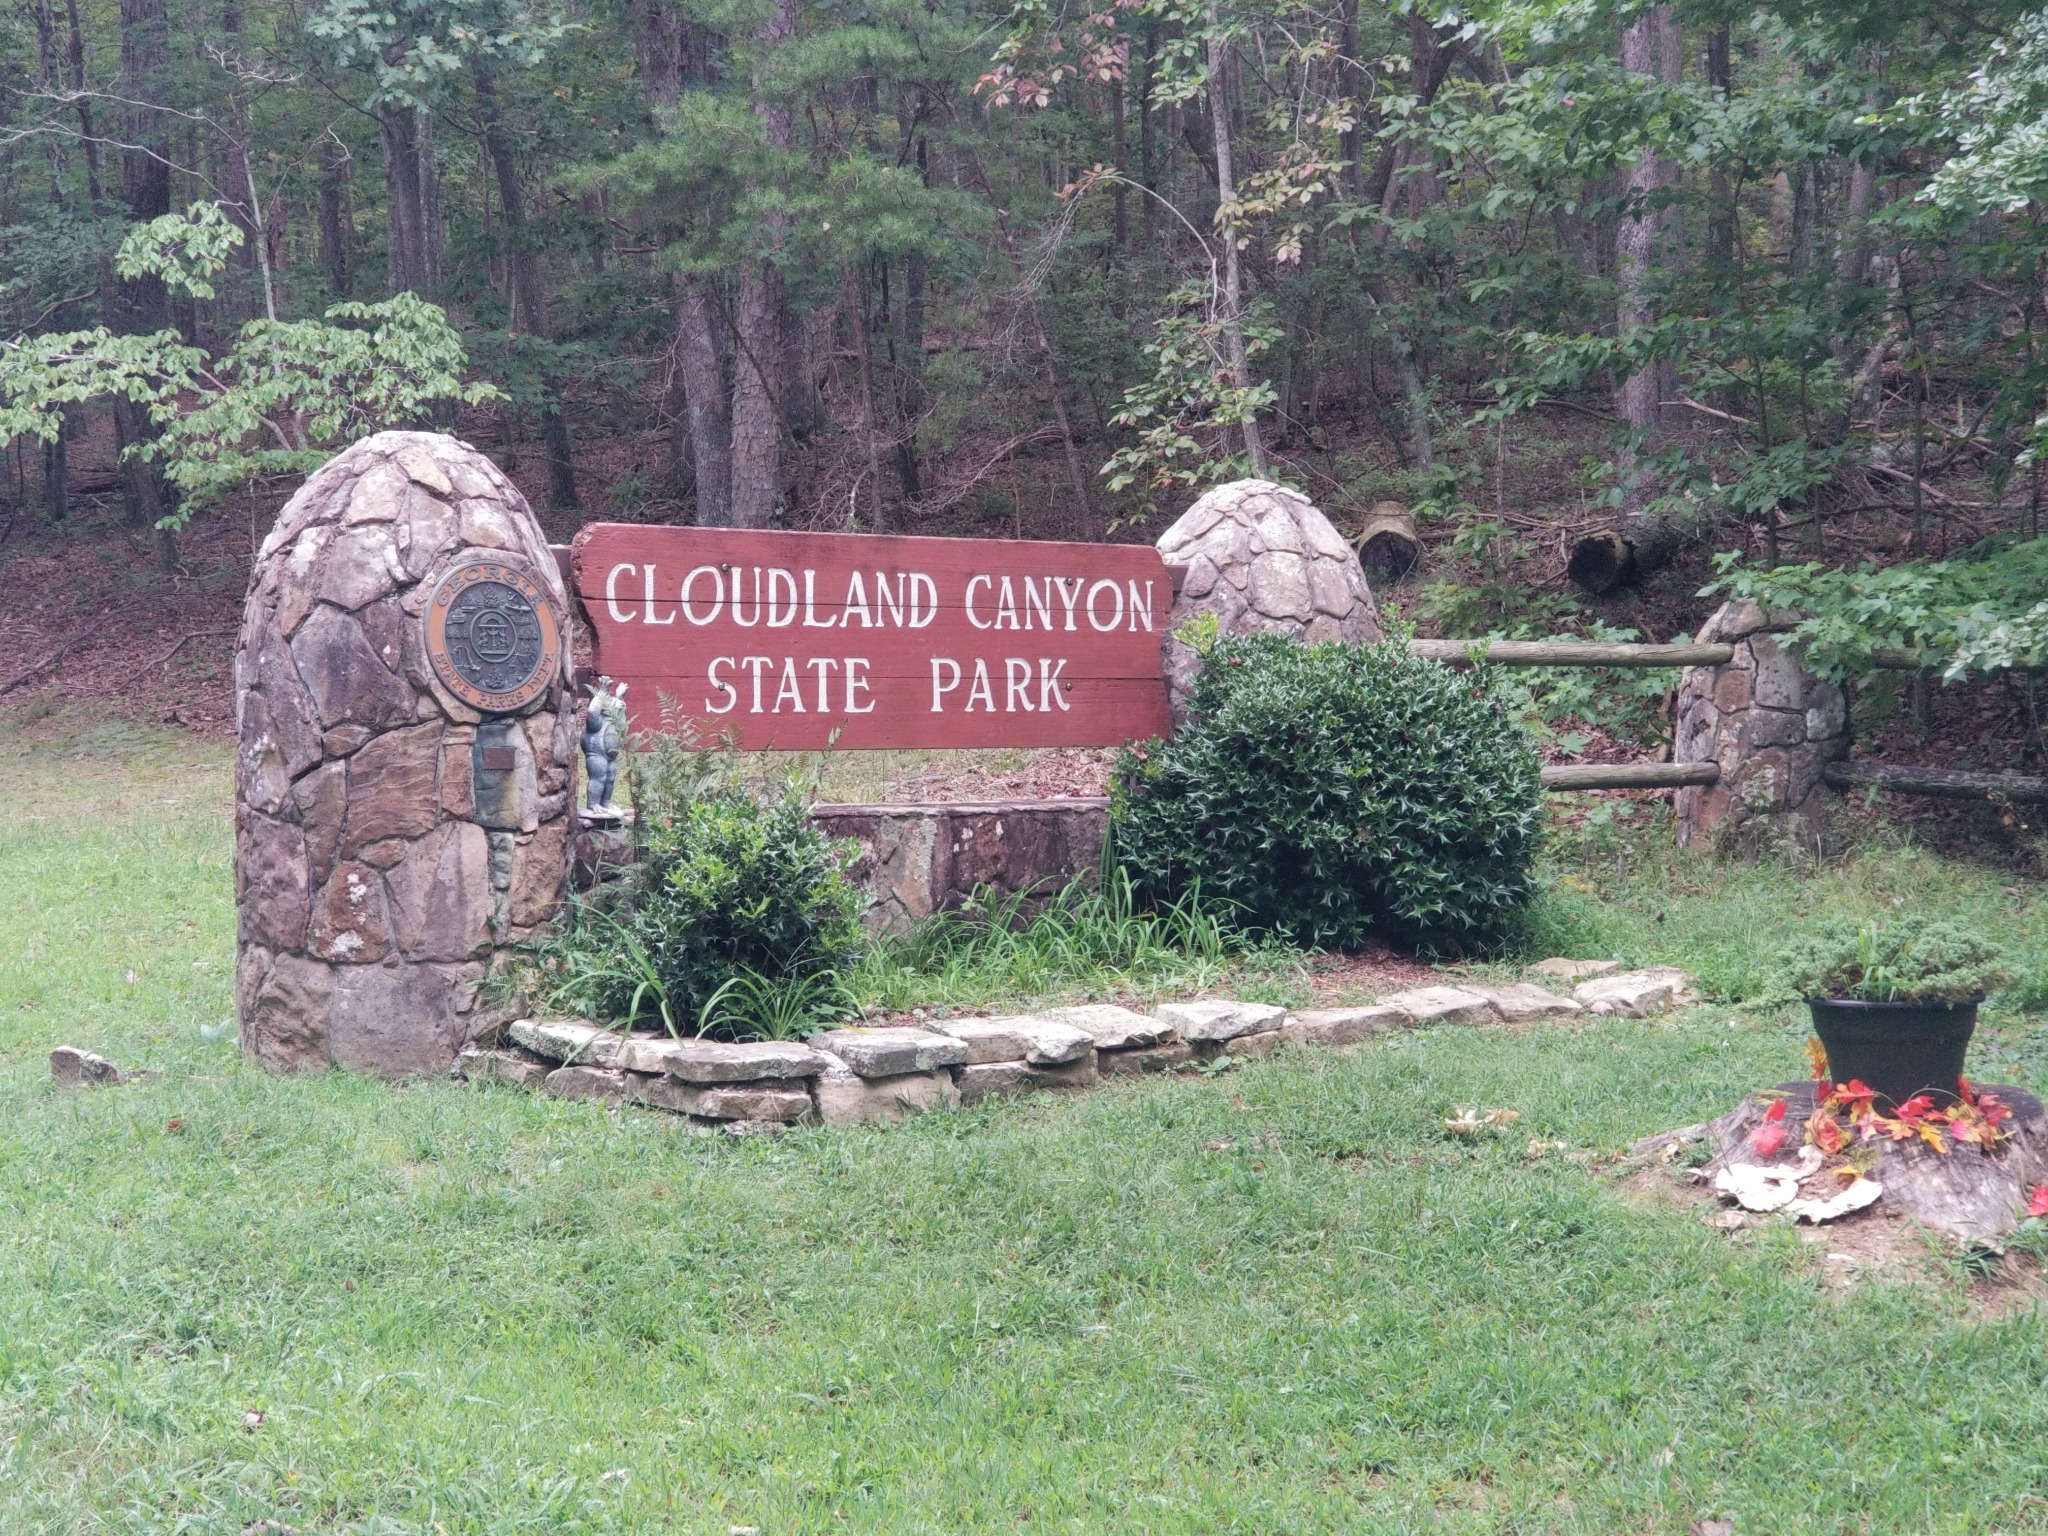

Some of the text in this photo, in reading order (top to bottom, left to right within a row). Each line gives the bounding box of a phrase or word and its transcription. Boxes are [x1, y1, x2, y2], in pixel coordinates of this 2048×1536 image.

[436, 565, 544, 611] GEORGIA
[604, 562, 1155, 633] CLOUDLAND CANYON
[434, 652, 471, 698] STATE
[705, 656, 1071, 714] STATE PARK
